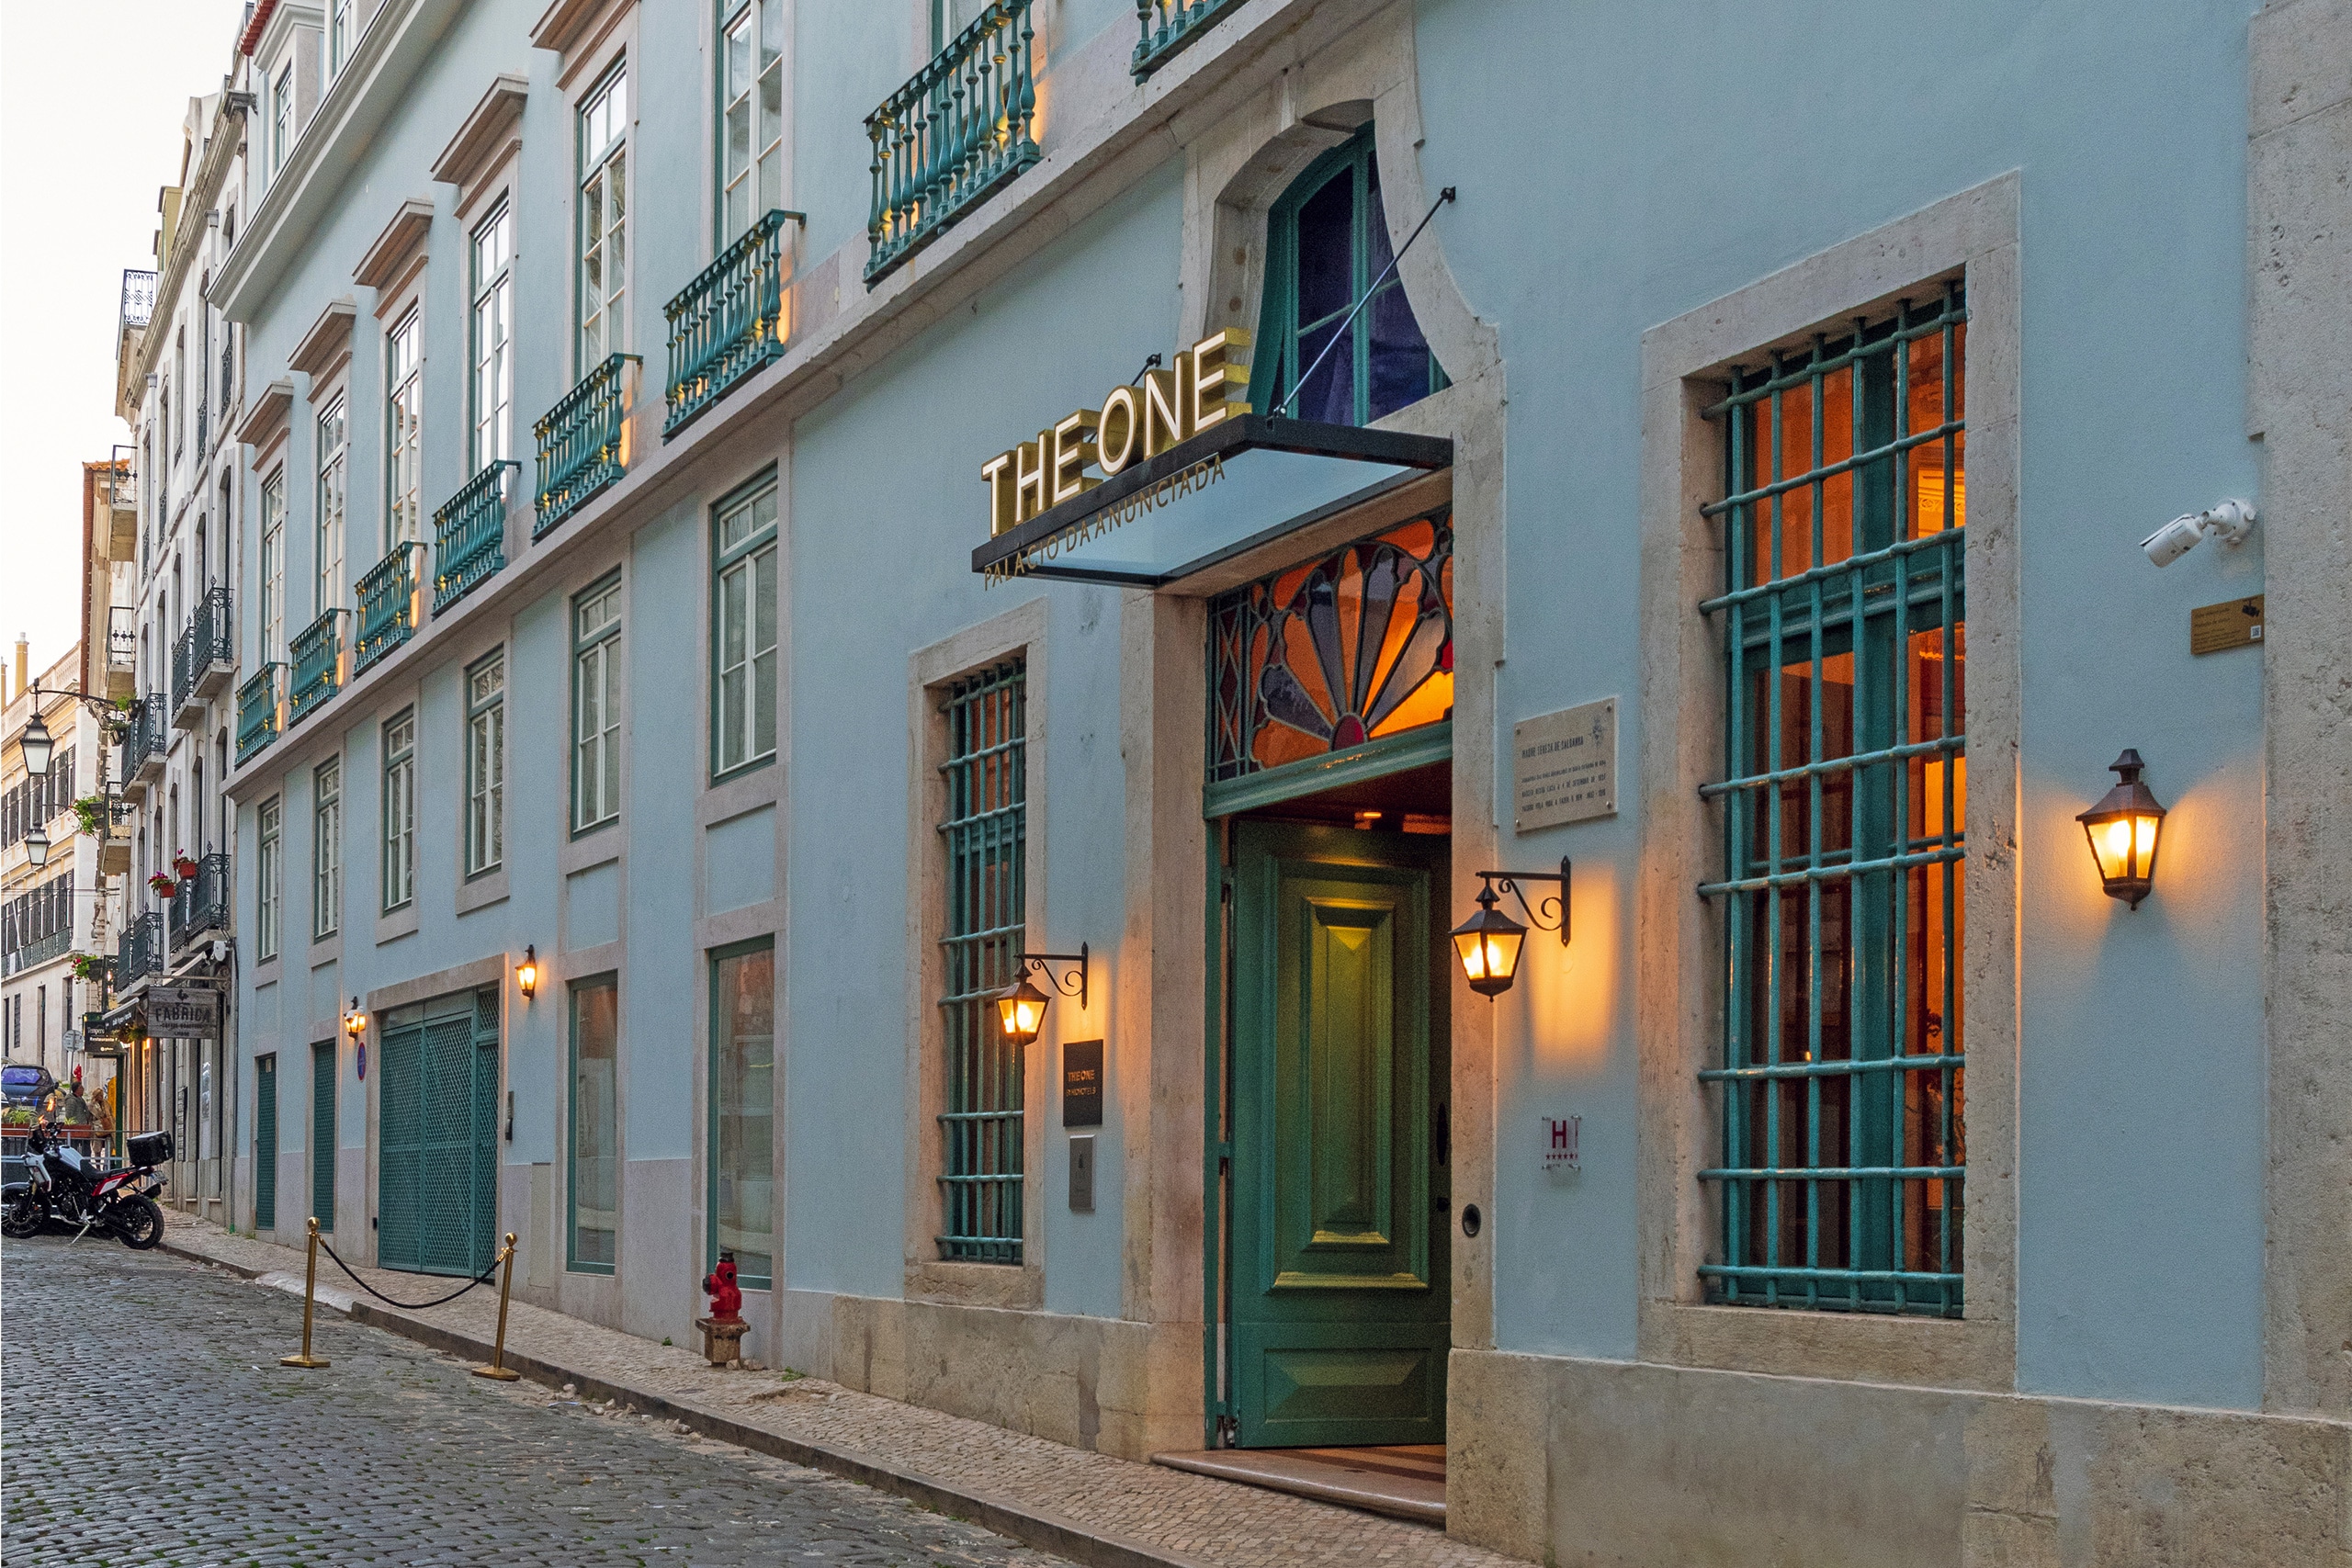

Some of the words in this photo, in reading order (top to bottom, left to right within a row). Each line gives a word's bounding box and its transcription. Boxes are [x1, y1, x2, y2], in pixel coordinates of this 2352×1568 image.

[981, 409, 1097, 539] THE
[1097, 327, 1250, 476] ONE
[983, 535, 1059, 591] PALÁCIO
[1065, 521, 1091, 552] DA
[1094, 455, 1226, 539] ANUNCIADA
[155, 1007, 210, 1022] FABRICA
[1552, 1120, 1566, 1148] H
